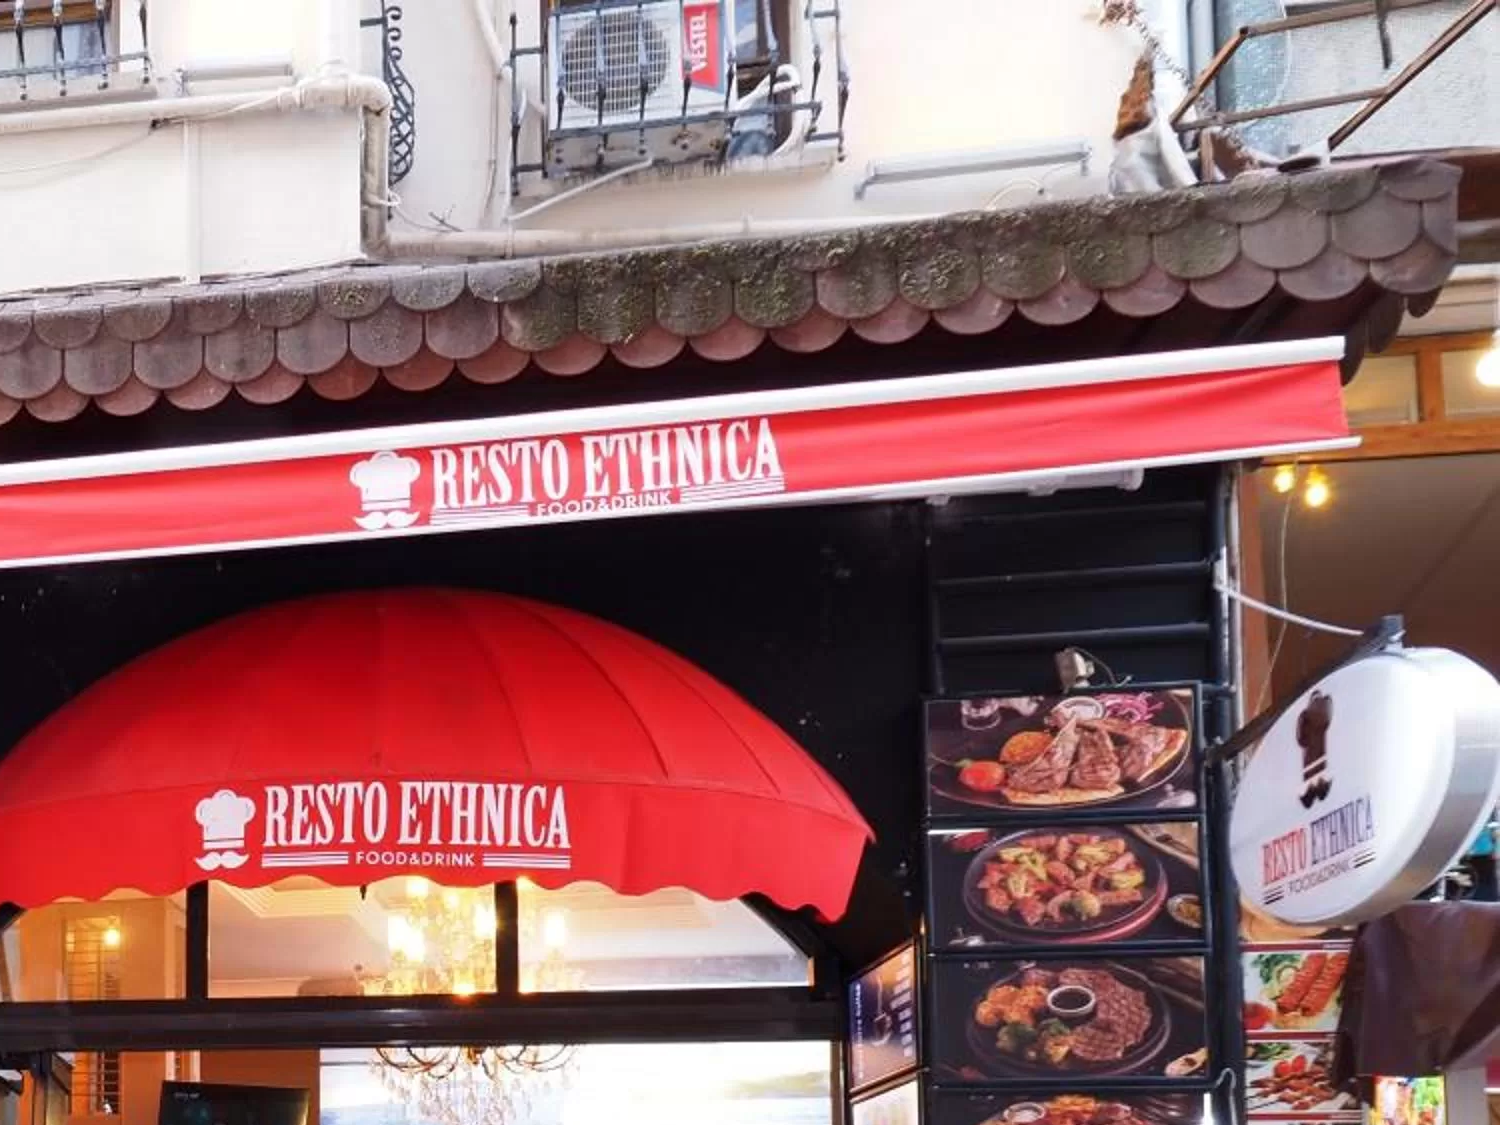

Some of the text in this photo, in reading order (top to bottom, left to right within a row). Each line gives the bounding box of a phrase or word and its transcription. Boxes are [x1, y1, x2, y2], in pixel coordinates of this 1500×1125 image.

[430, 417, 784, 510] RESTO ETHNICA
[536, 488, 672, 517] FOOD&DRINK
[262, 780, 571, 849] RESTO ETHNICA
[1261, 795, 1376, 886] RESTO ETHNICA
[355, 850, 475, 867] FOOD&DRINK
